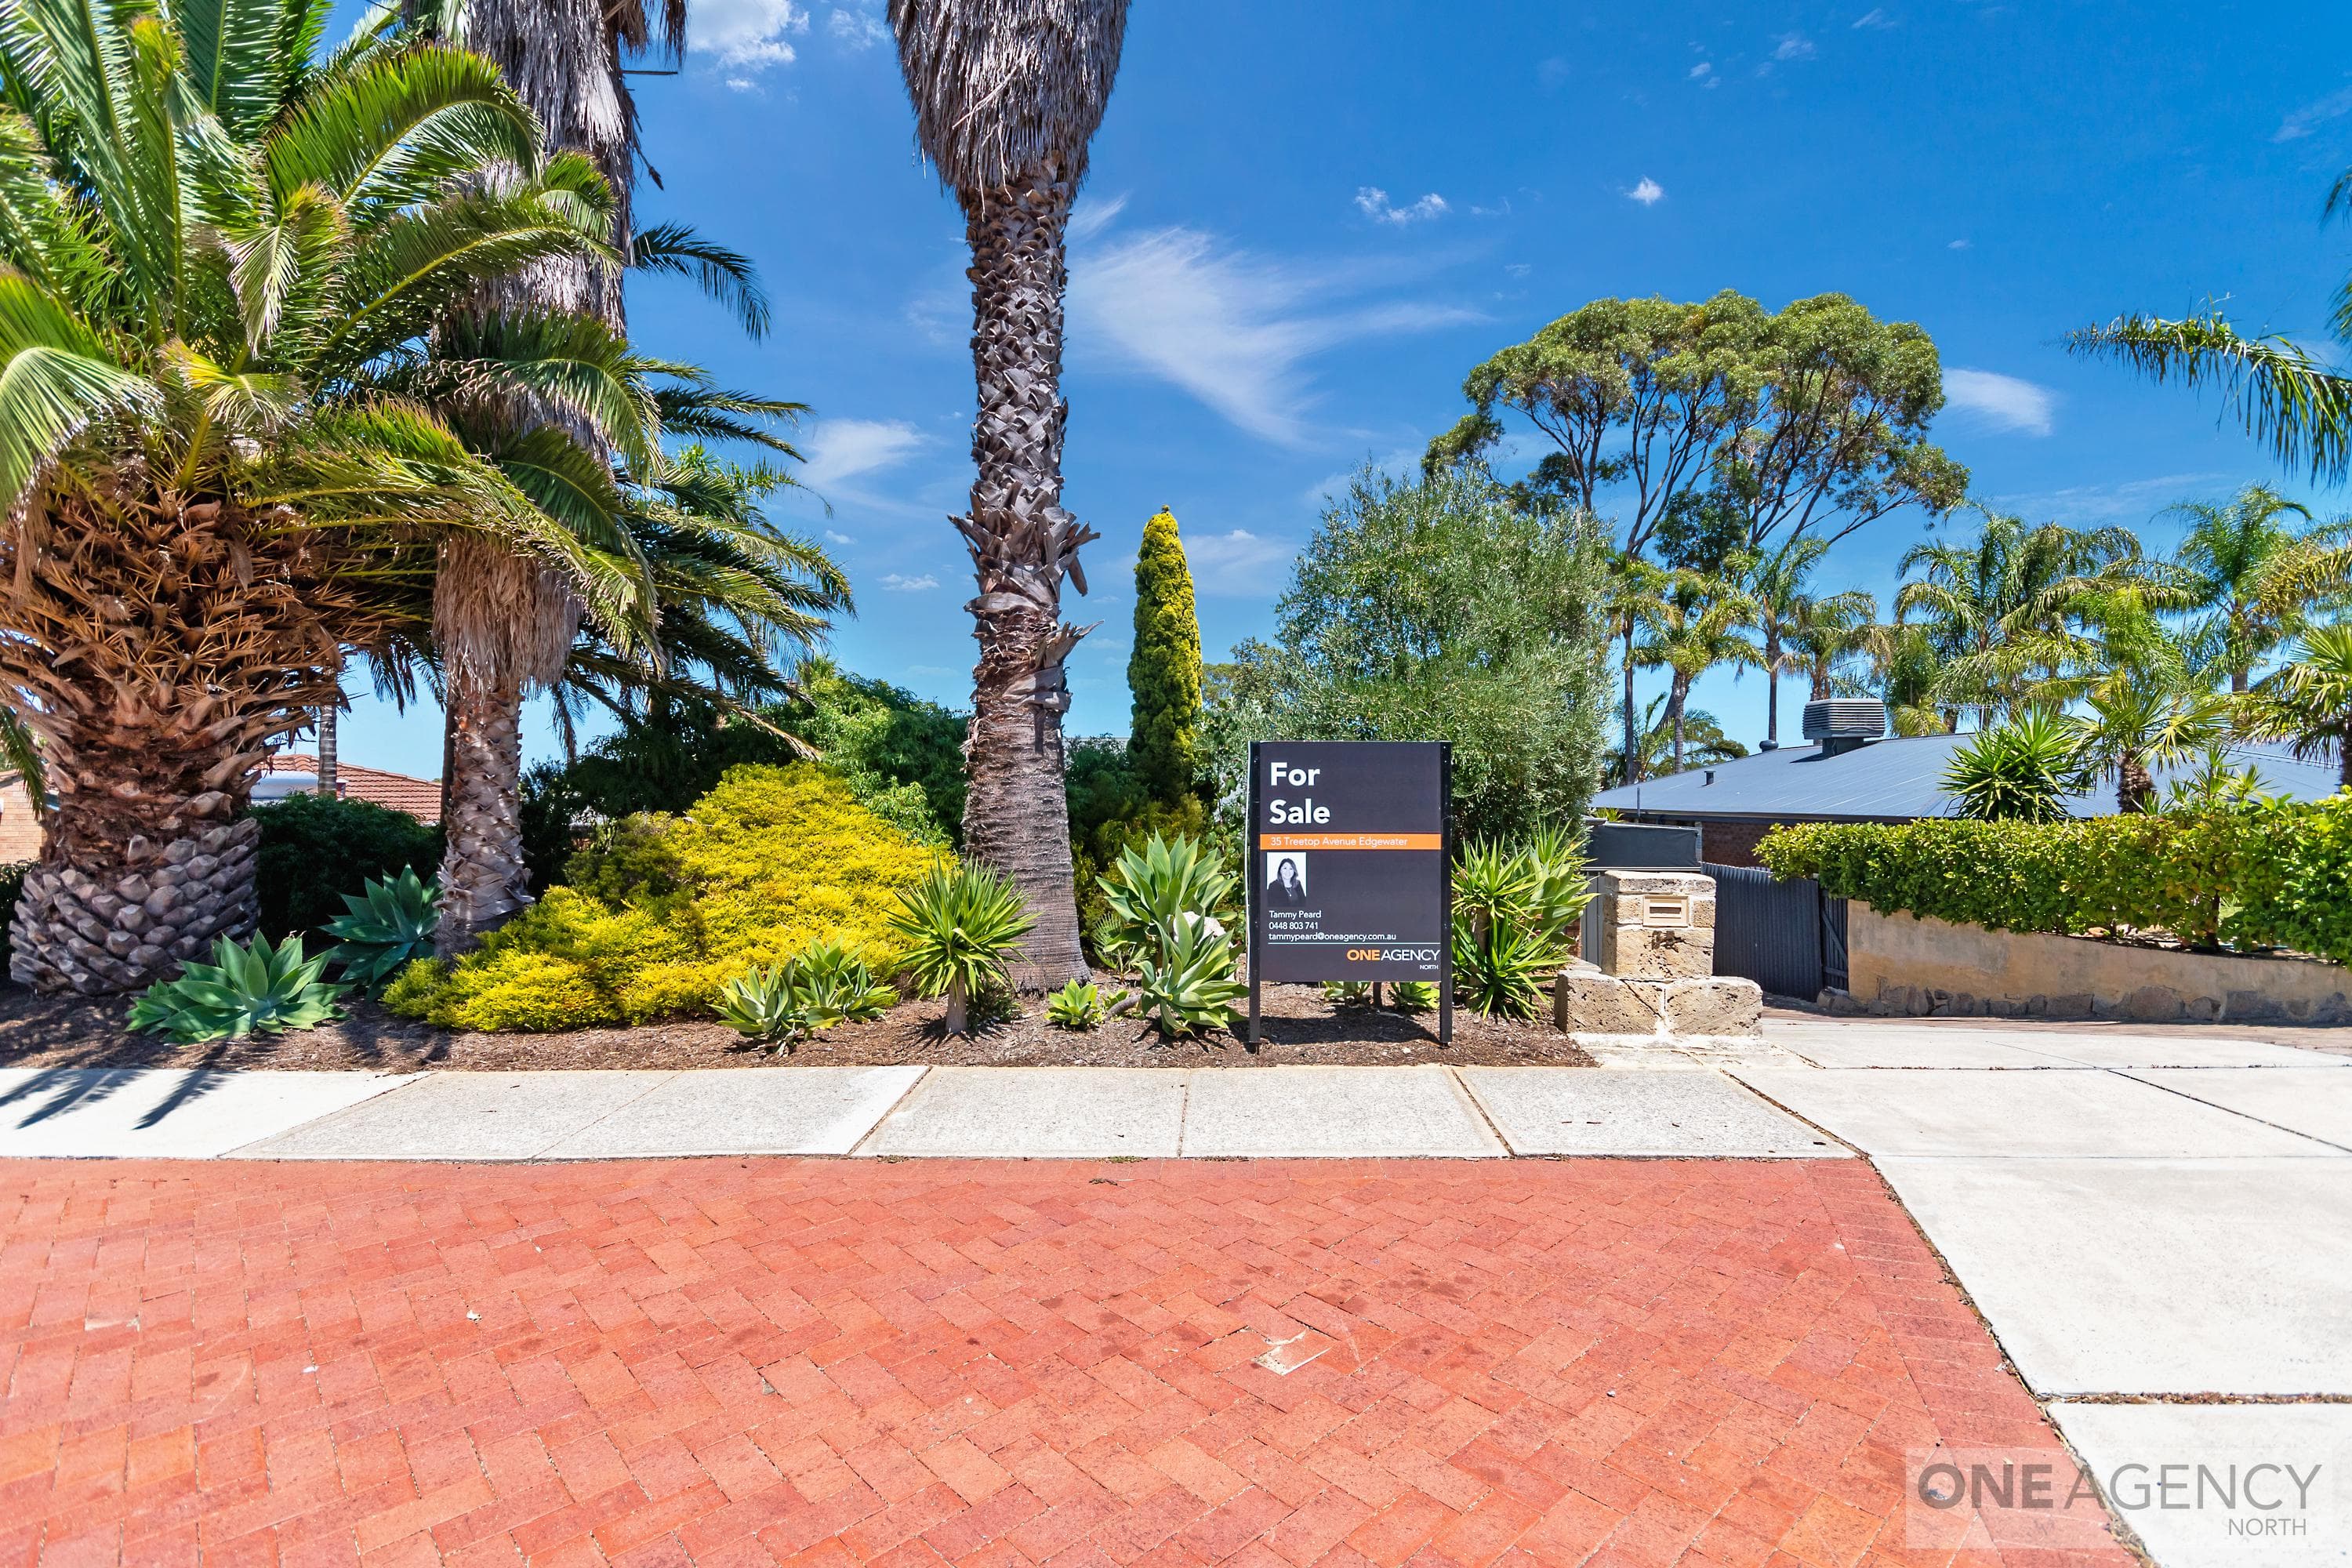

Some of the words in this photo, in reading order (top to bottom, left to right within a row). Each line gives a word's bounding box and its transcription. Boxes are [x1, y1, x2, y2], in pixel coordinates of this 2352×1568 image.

[1270, 761, 1321, 786] For
[1269, 798, 1330, 825] Sale
[1271, 837, 1282, 847] 35
[1284, 836, 1320, 848] Treetop
[1323, 836, 1357, 847] Avenue
[1359, 836, 1408, 849] Edgewater
[1269, 909, 1298, 920] Tammy
[1299, 909, 1322, 920] Peard
[1269, 921, 1288, 931] 0448
[1289, 921, 1304, 931] 803
[1305, 921, 1319, 931] 741
[1269, 931, 1397, 942] tammypeard@oneagency.com.au
